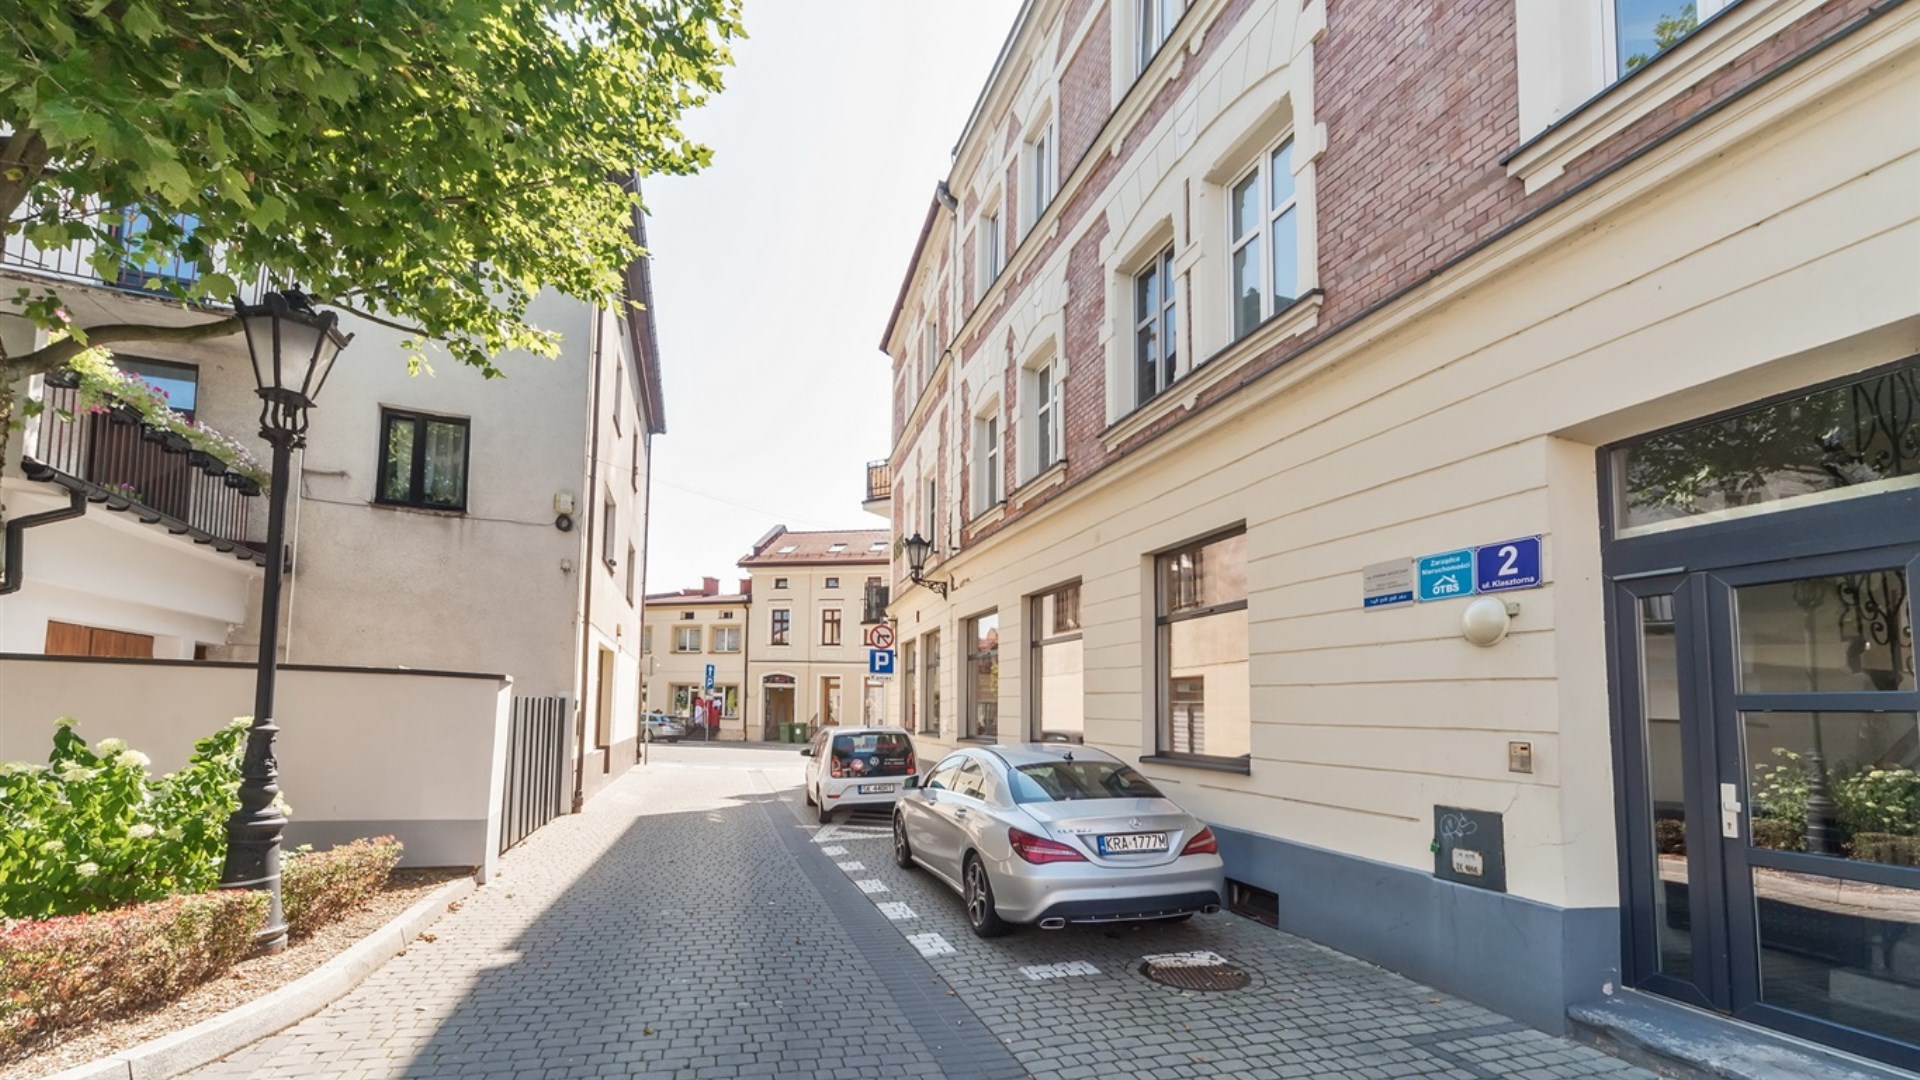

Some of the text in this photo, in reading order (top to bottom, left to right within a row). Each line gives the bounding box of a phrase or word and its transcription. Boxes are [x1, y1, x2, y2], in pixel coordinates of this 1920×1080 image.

[1497, 545, 1518, 576] 2
[1432, 582, 1460, 595] OTBS
[1492, 576, 1535, 588] Klasztorna
[874, 652, 889, 671] P
[1105, 834, 1166, 851] KRA 1777M
